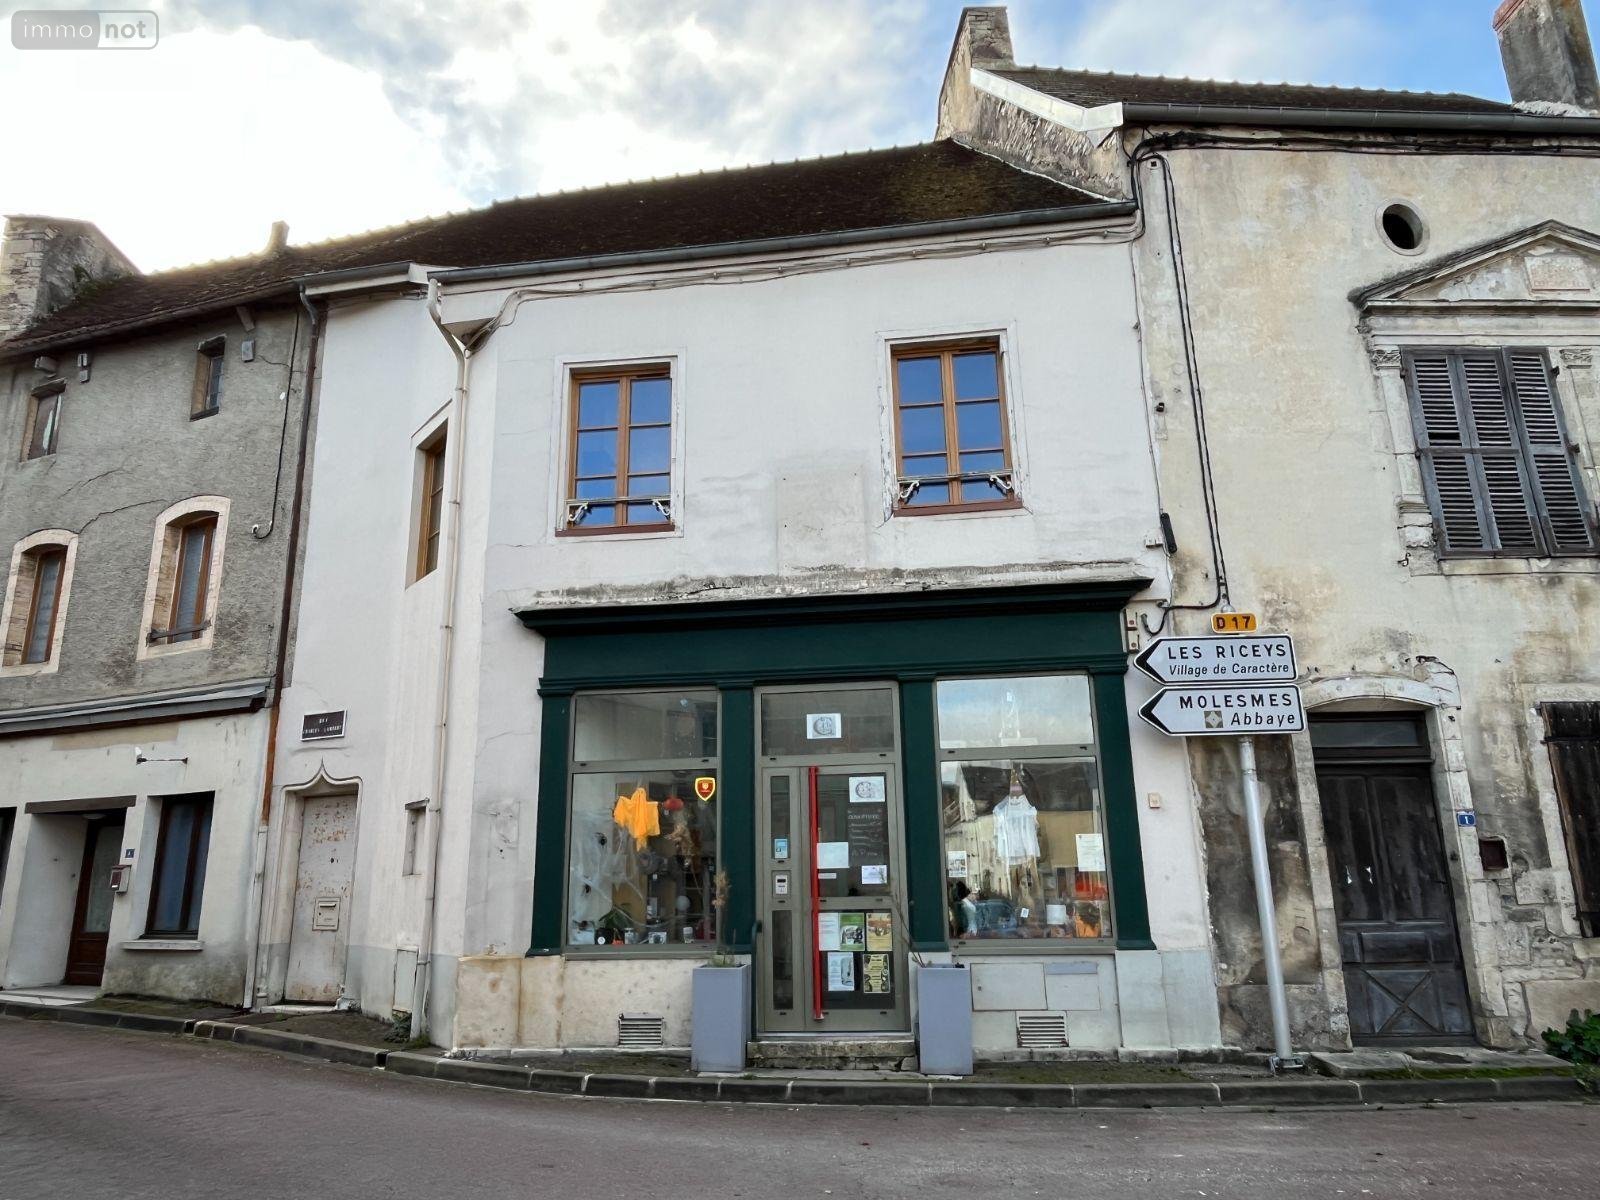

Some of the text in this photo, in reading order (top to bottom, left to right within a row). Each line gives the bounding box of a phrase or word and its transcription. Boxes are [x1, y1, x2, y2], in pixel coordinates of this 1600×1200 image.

[1168, 644, 1286, 660] LES RICEYS
[1169, 662, 1289, 677] Village de Caractère
[1179, 694, 1292, 709] MOLESMES
[1230, 712, 1295, 727] Abbaye
